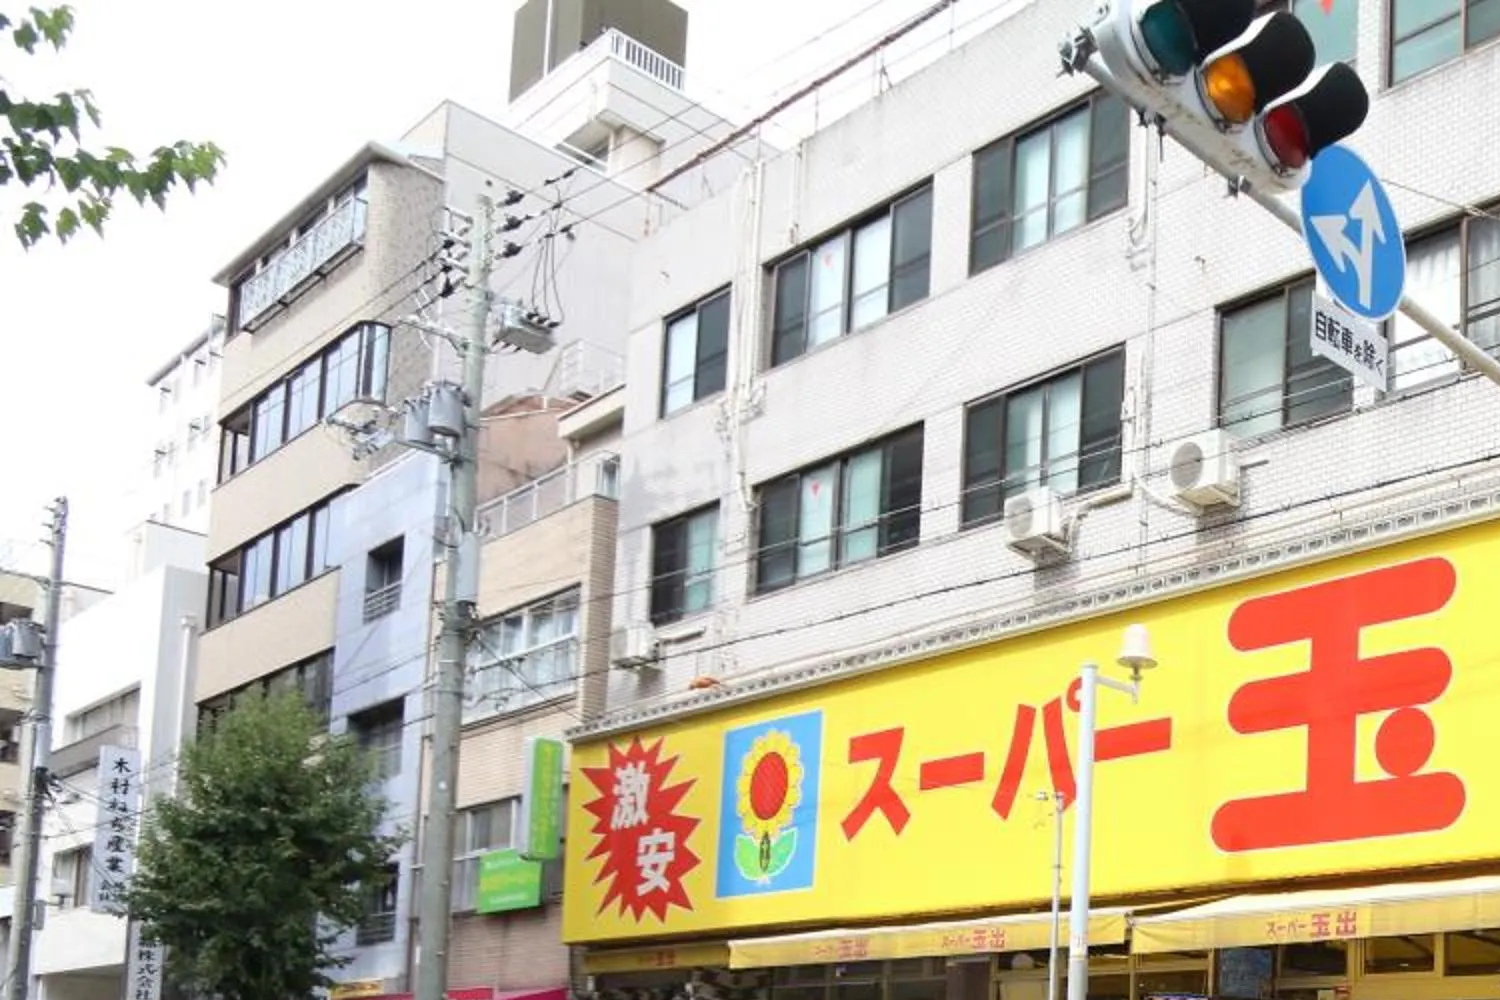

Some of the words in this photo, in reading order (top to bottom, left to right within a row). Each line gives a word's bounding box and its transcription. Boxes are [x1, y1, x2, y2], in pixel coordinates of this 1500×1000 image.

[1314, 310, 1385, 379] 自転車を除く
[611, 762, 673, 896] 激安
[1266, 911, 1357, 941] スーパー玉出
